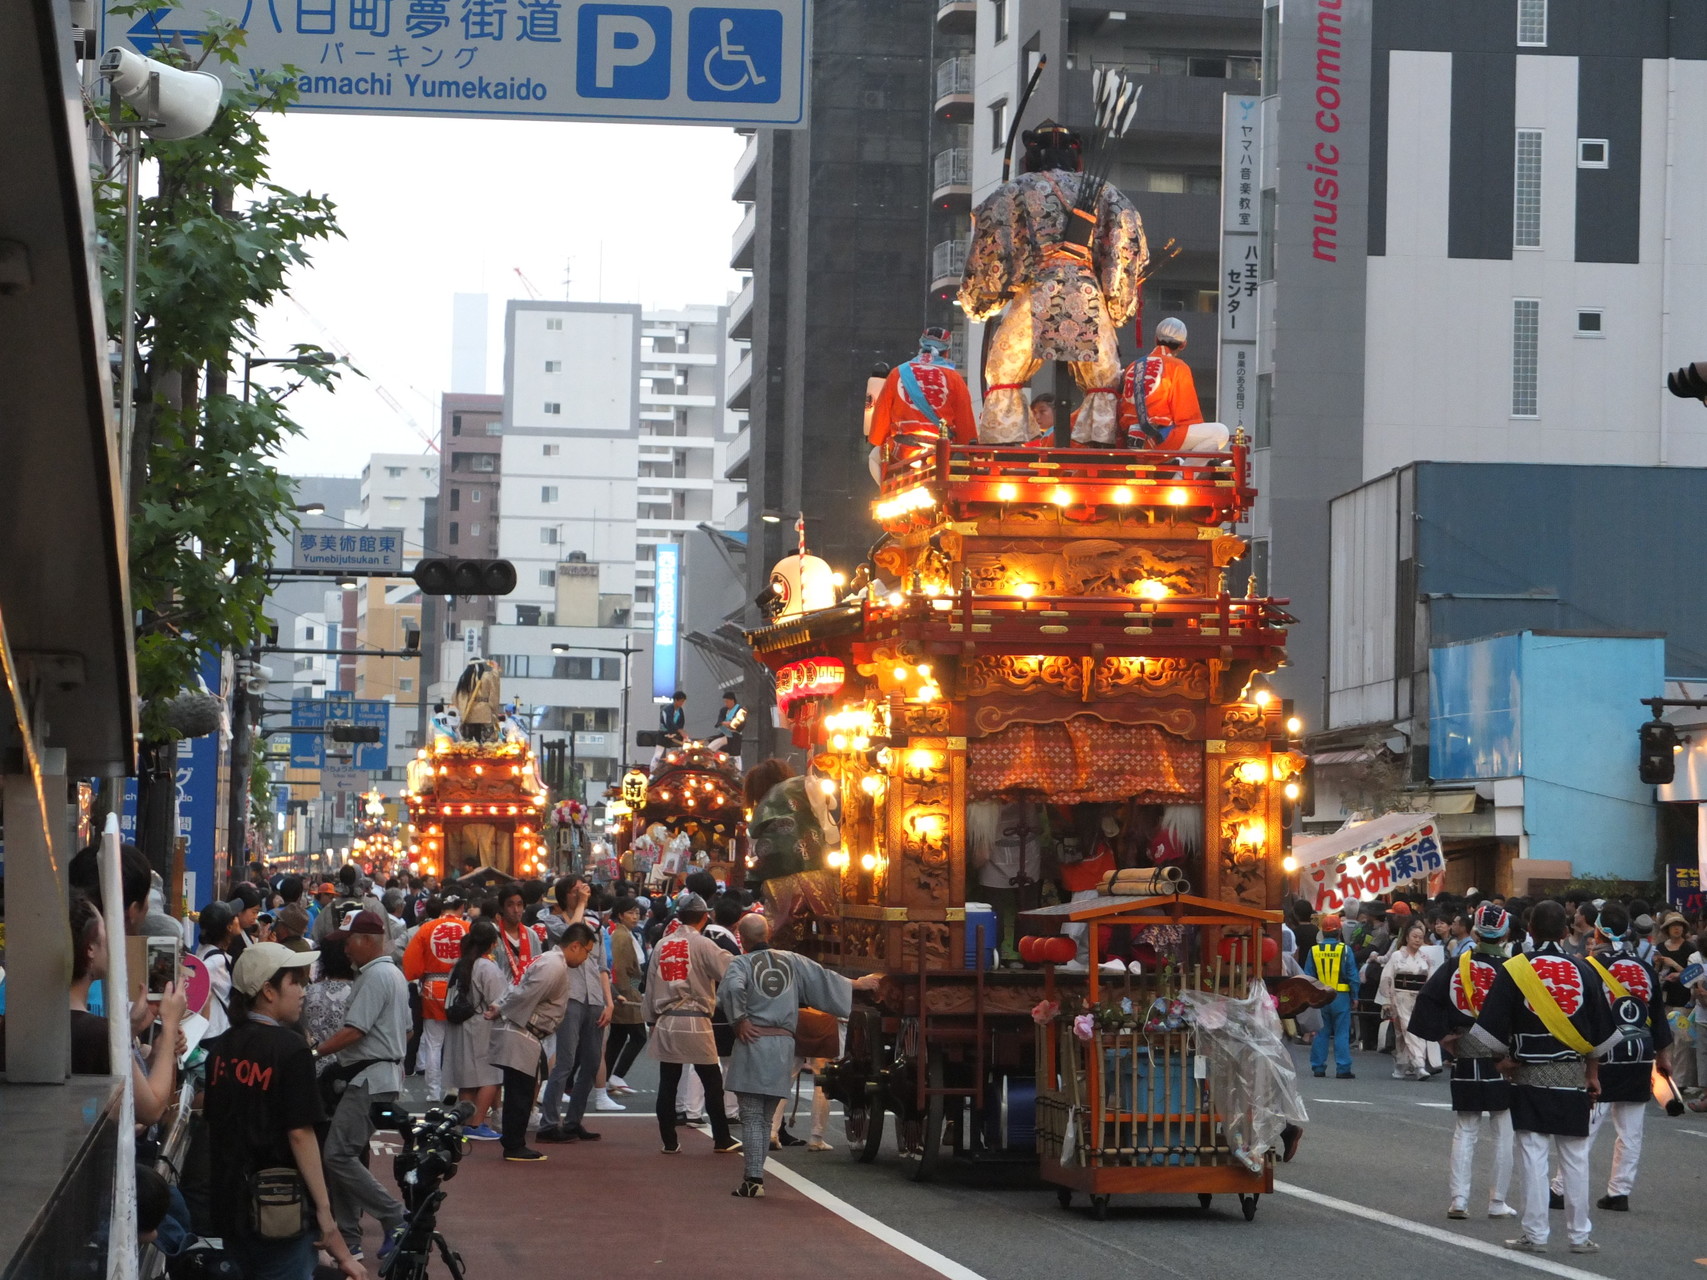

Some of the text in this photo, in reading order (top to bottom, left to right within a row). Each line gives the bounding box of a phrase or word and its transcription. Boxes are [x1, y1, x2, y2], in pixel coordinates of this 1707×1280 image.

[240, 0, 562, 43] 八日町夢街道
[320, 42, 479, 70] パーキング
[595, 15, 656, 88] P
[405, 73, 547, 101] Yumekaido
[1238, 125, 1253, 226] ヤマハ音楽教室
[1308, 141, 1341, 263] music
[1244, 245, 1258, 297] 八王子
[1227, 269, 1241, 330] センター
[300, 534, 396, 552] 夢美術館東
[303, 553, 381, 566] Yumebijutsukan
